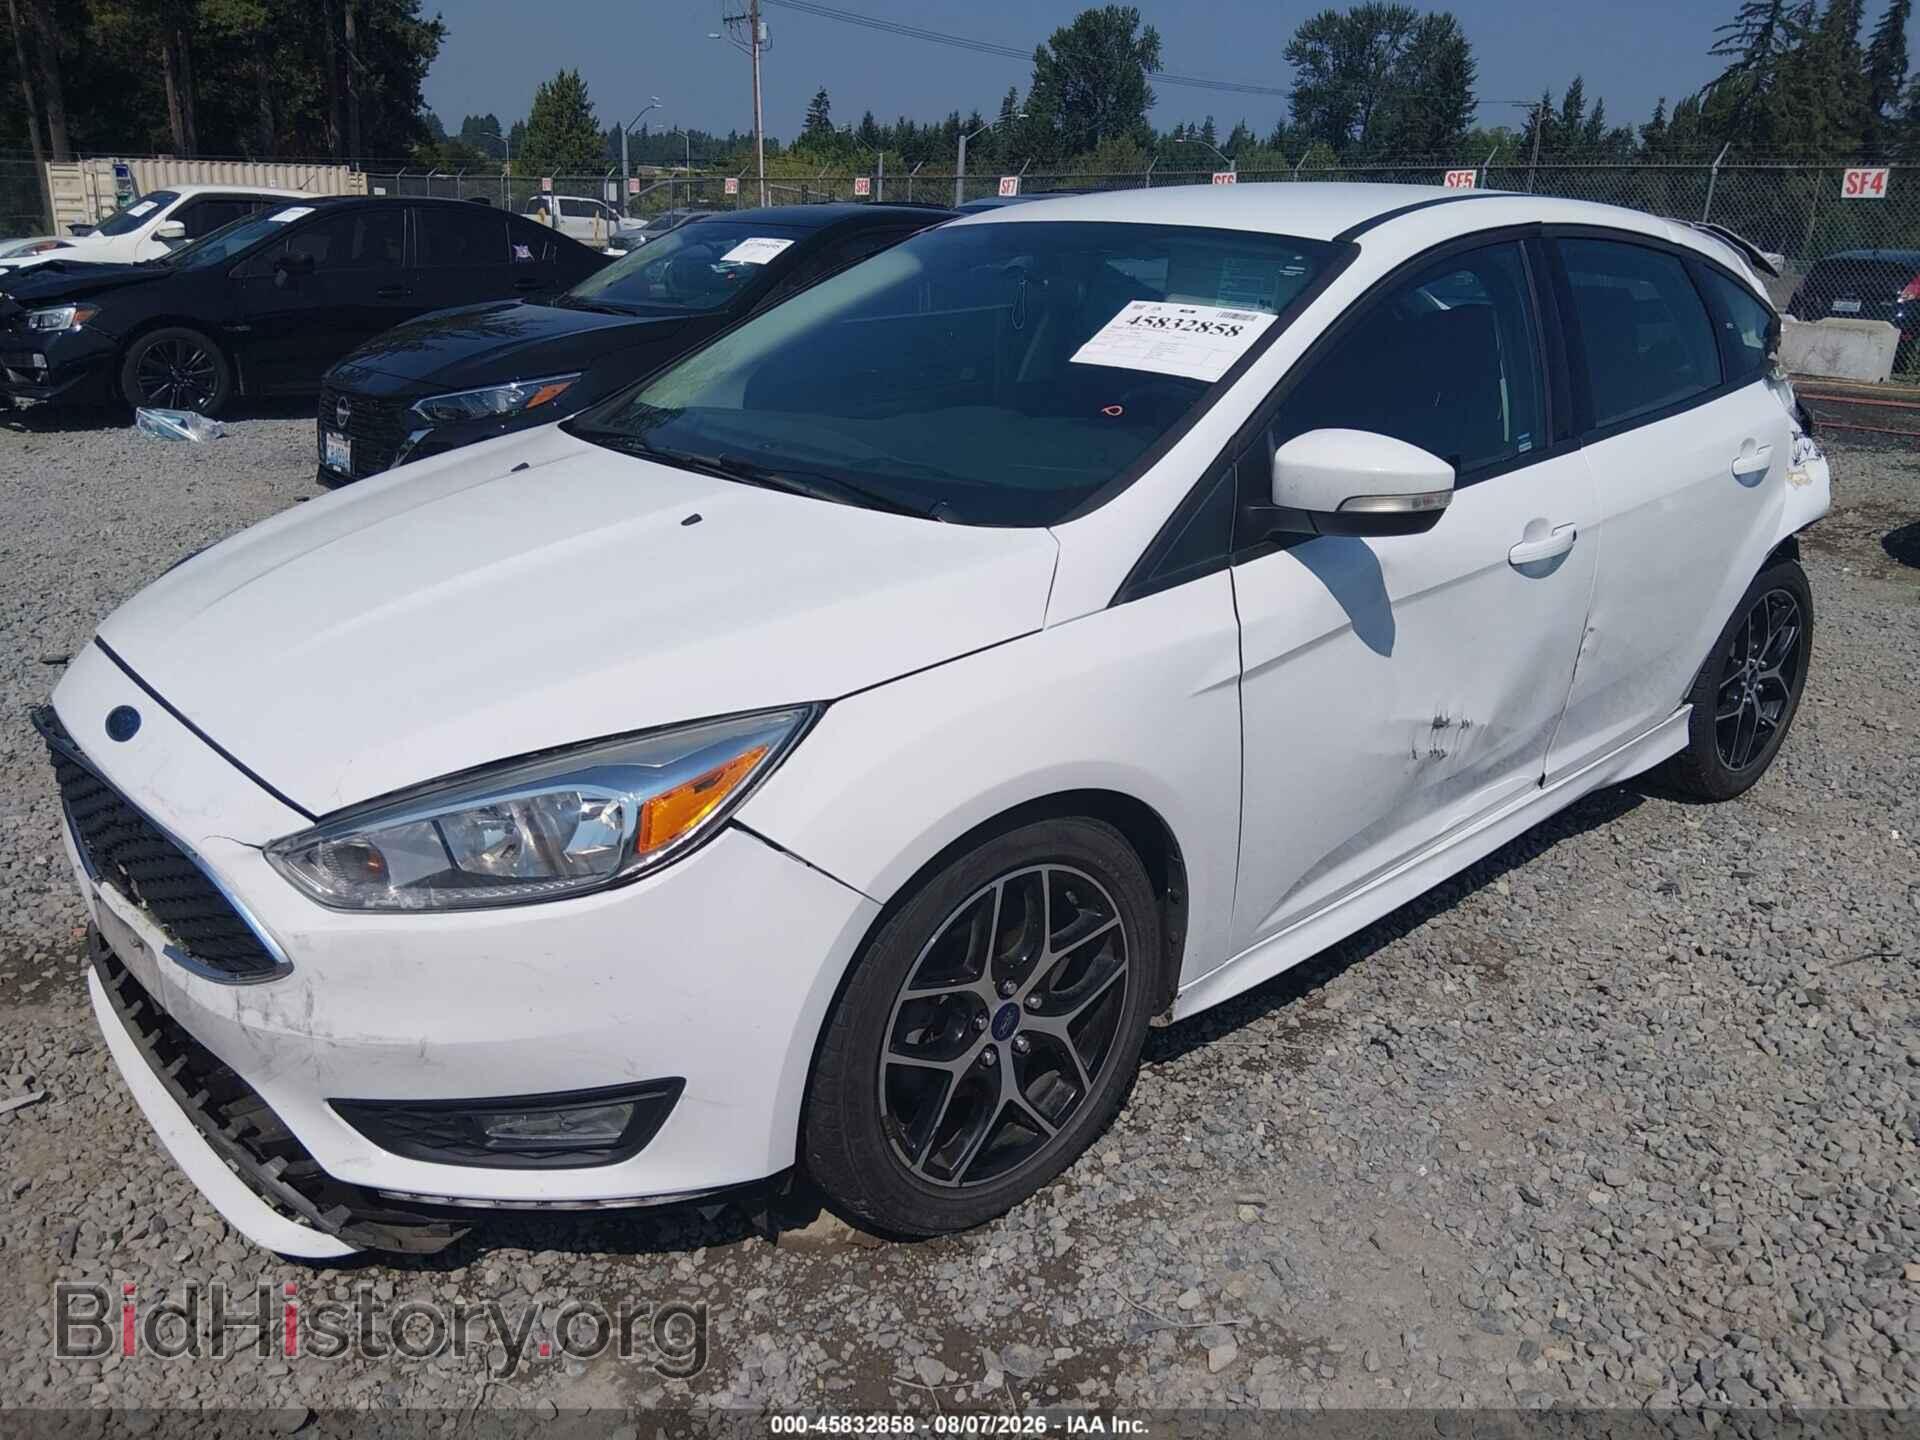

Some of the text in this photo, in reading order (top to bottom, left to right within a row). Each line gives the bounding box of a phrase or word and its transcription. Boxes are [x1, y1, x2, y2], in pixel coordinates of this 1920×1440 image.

[856, 180, 869, 193] SF8
[1001, 179, 1016, 194] SF7
[1446, 172, 1473, 188] SF5
[1846, 171, 1885, 195] SF4
[1126, 314, 1244, 338] 45832858
